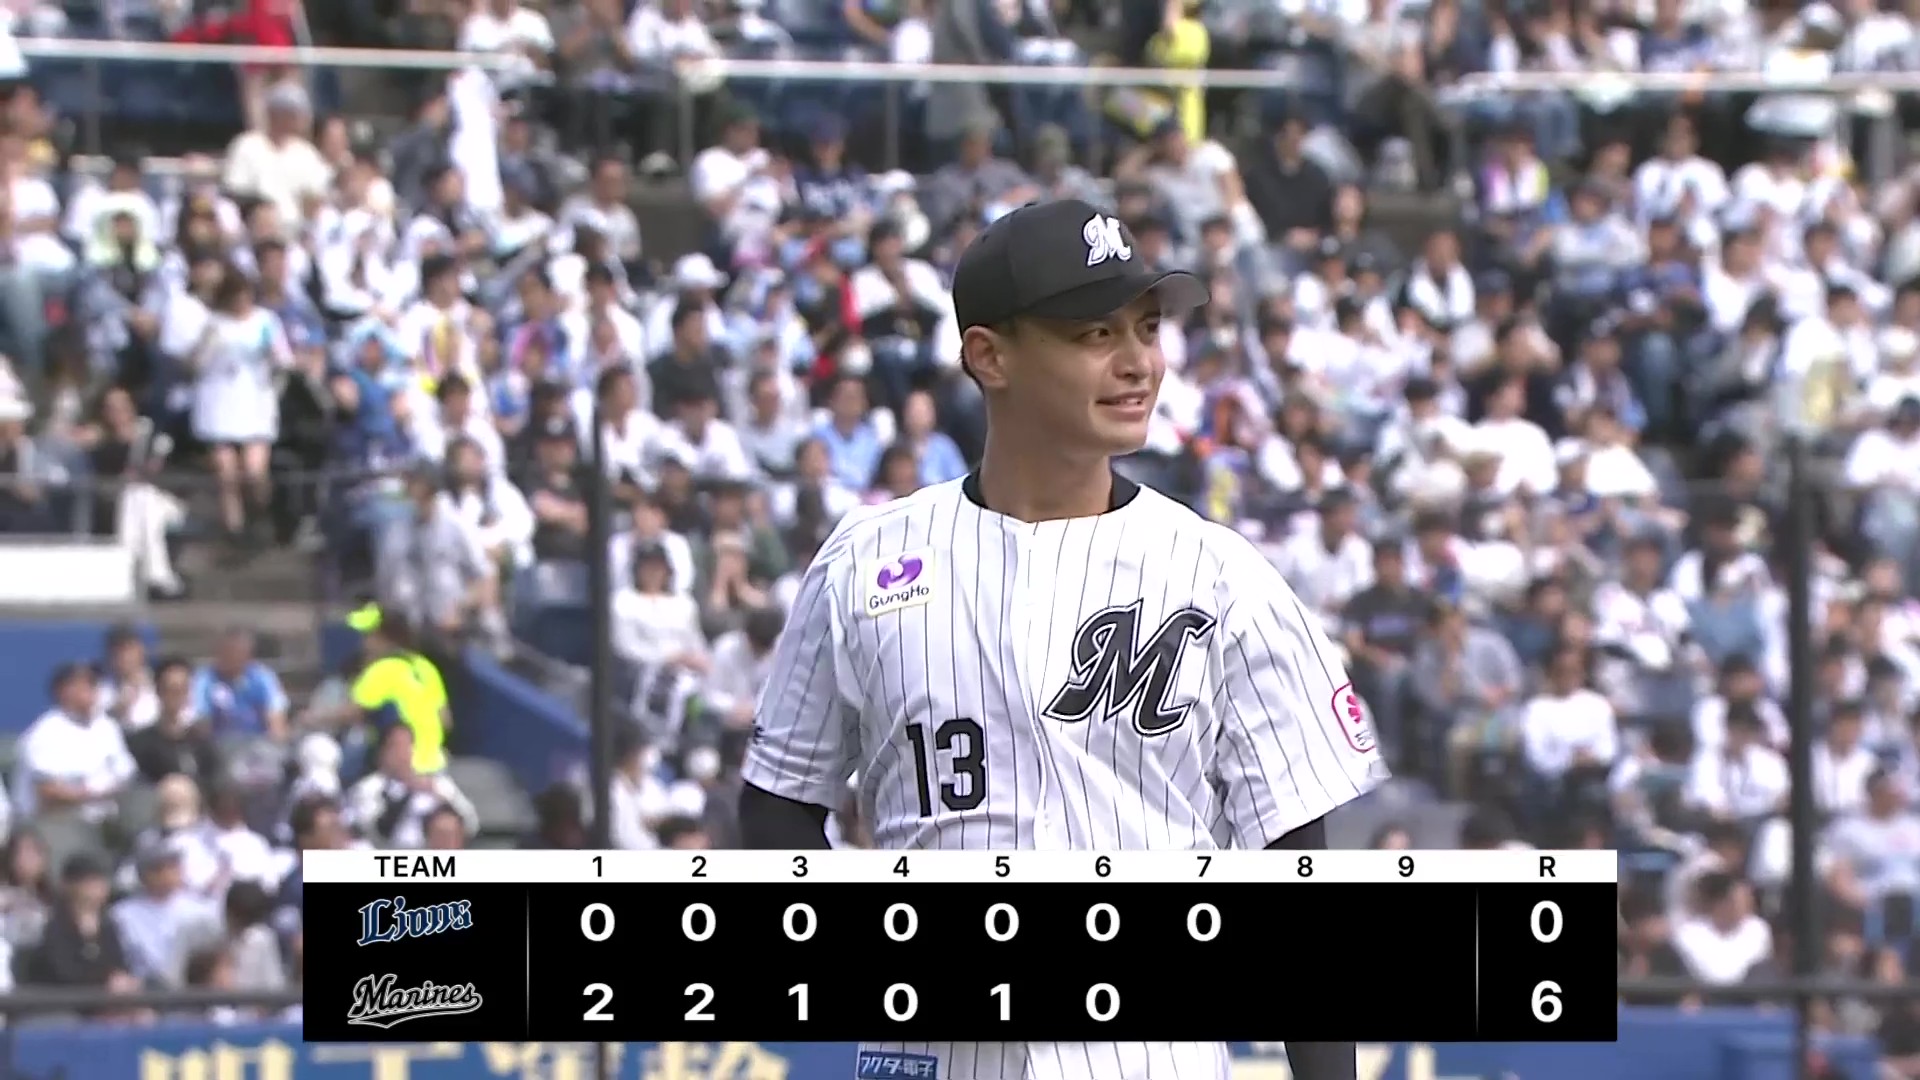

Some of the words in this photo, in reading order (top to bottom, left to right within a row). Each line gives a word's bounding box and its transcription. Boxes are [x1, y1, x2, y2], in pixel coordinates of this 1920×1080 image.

[1082, 211, 1132, 267] M
[869, 584, 930, 610] GungHo
[1040, 597, 1217, 737] M
[906, 717, 986, 818] 13
